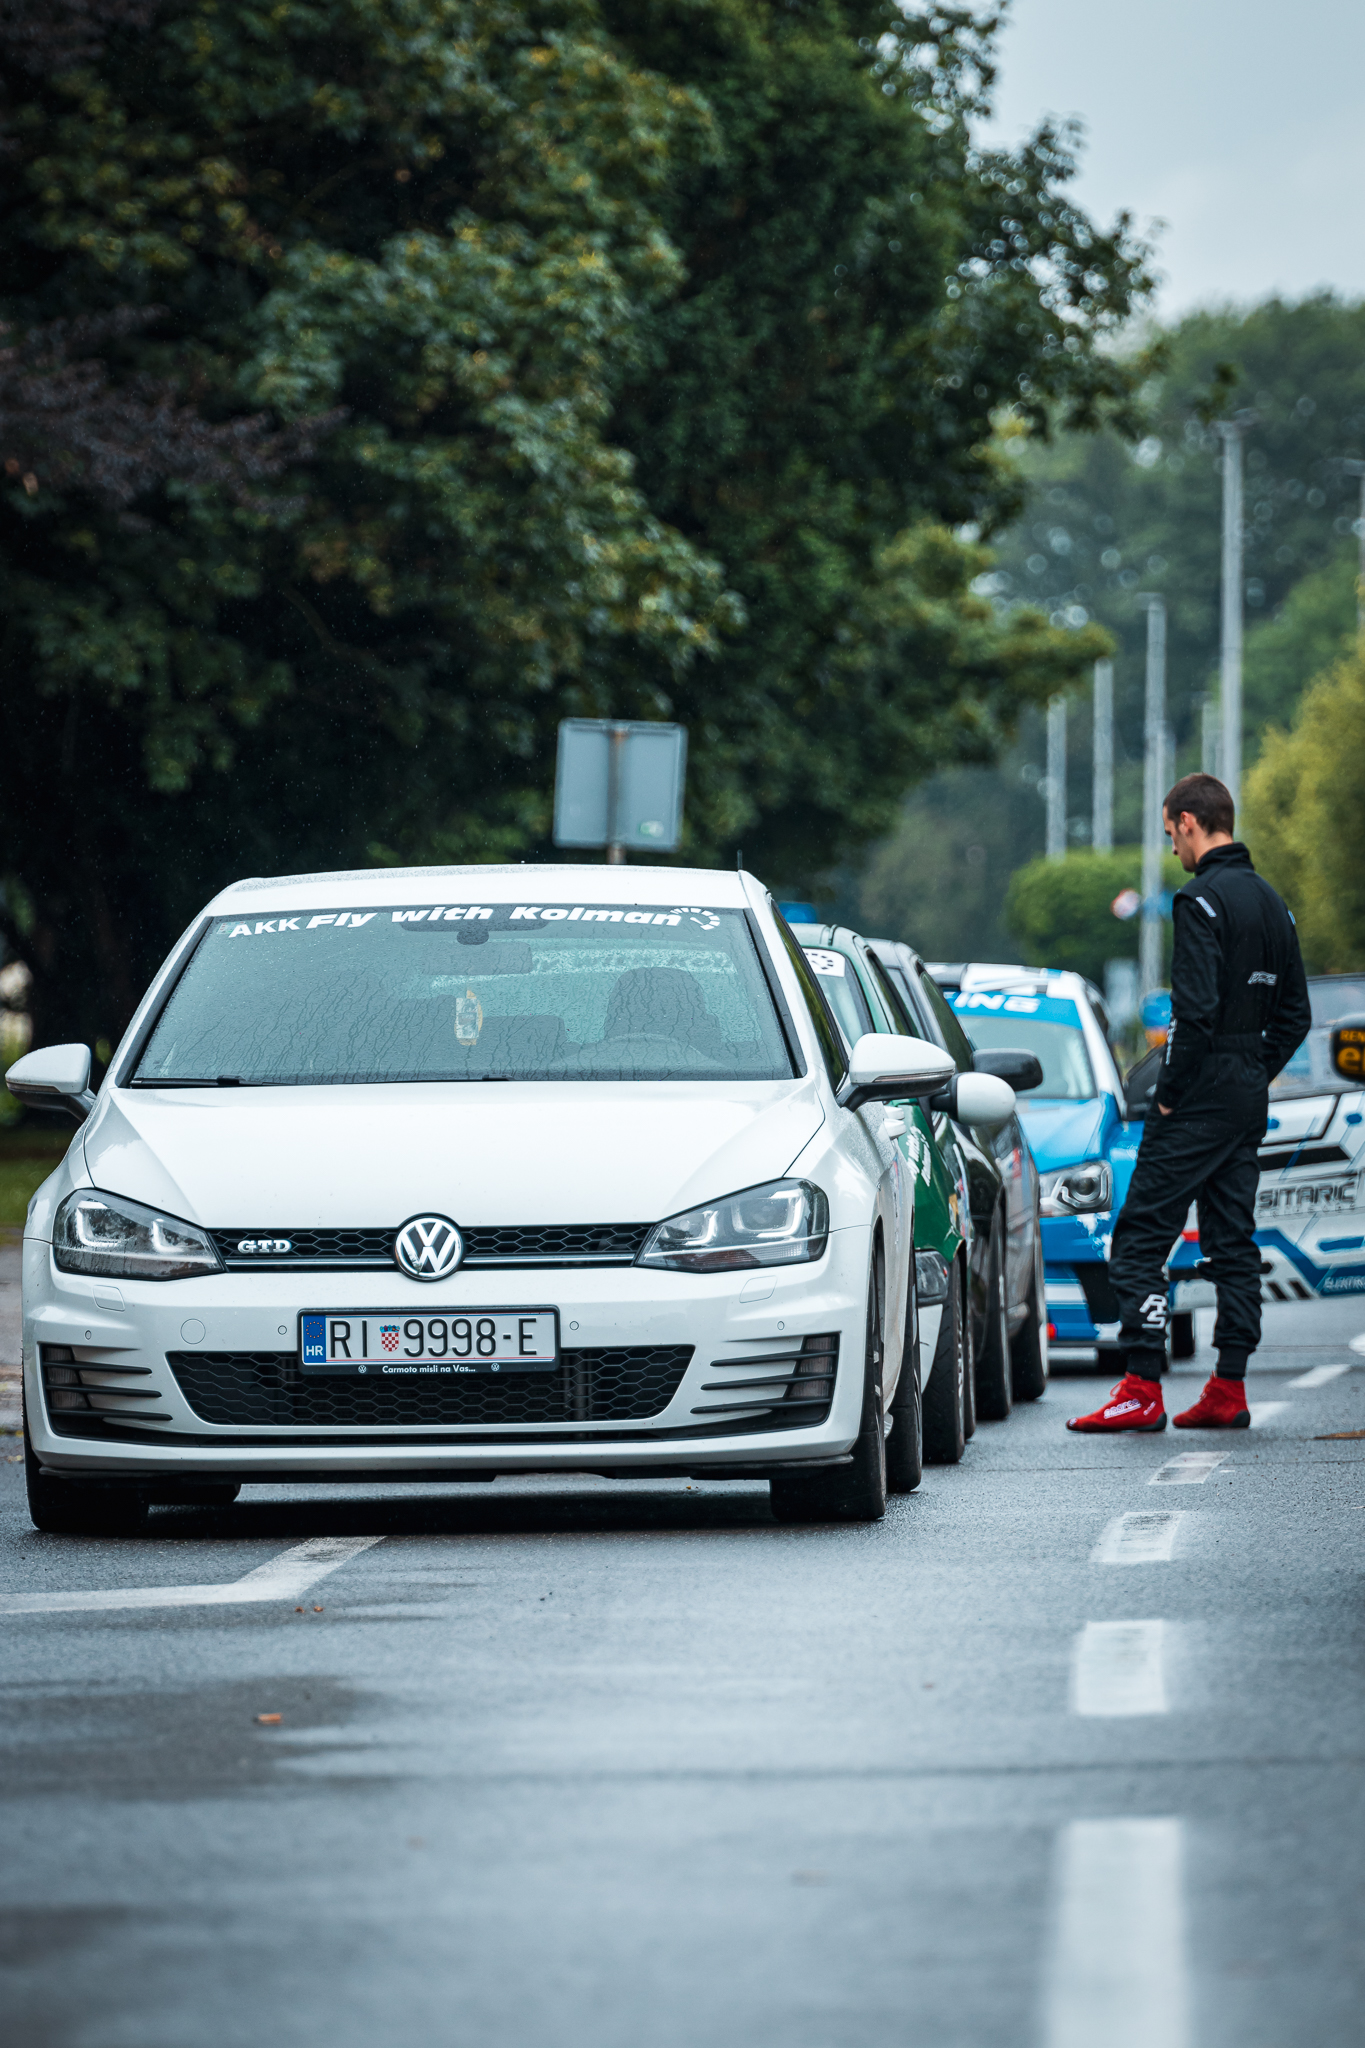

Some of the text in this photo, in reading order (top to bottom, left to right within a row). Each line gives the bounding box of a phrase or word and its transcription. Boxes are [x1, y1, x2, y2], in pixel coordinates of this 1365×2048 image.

[228, 906, 682, 938] AKK Fly with Kolman
[237, 1239, 292, 1254] GTD
[330, 1317, 537, 1358] RI 9998-E
[306, 1345, 324, 1356] HR
[382, 1365, 418, 1374] Carmoto
[419, 1364, 438, 1373] misli
[440, 1365, 451, 1373] na
